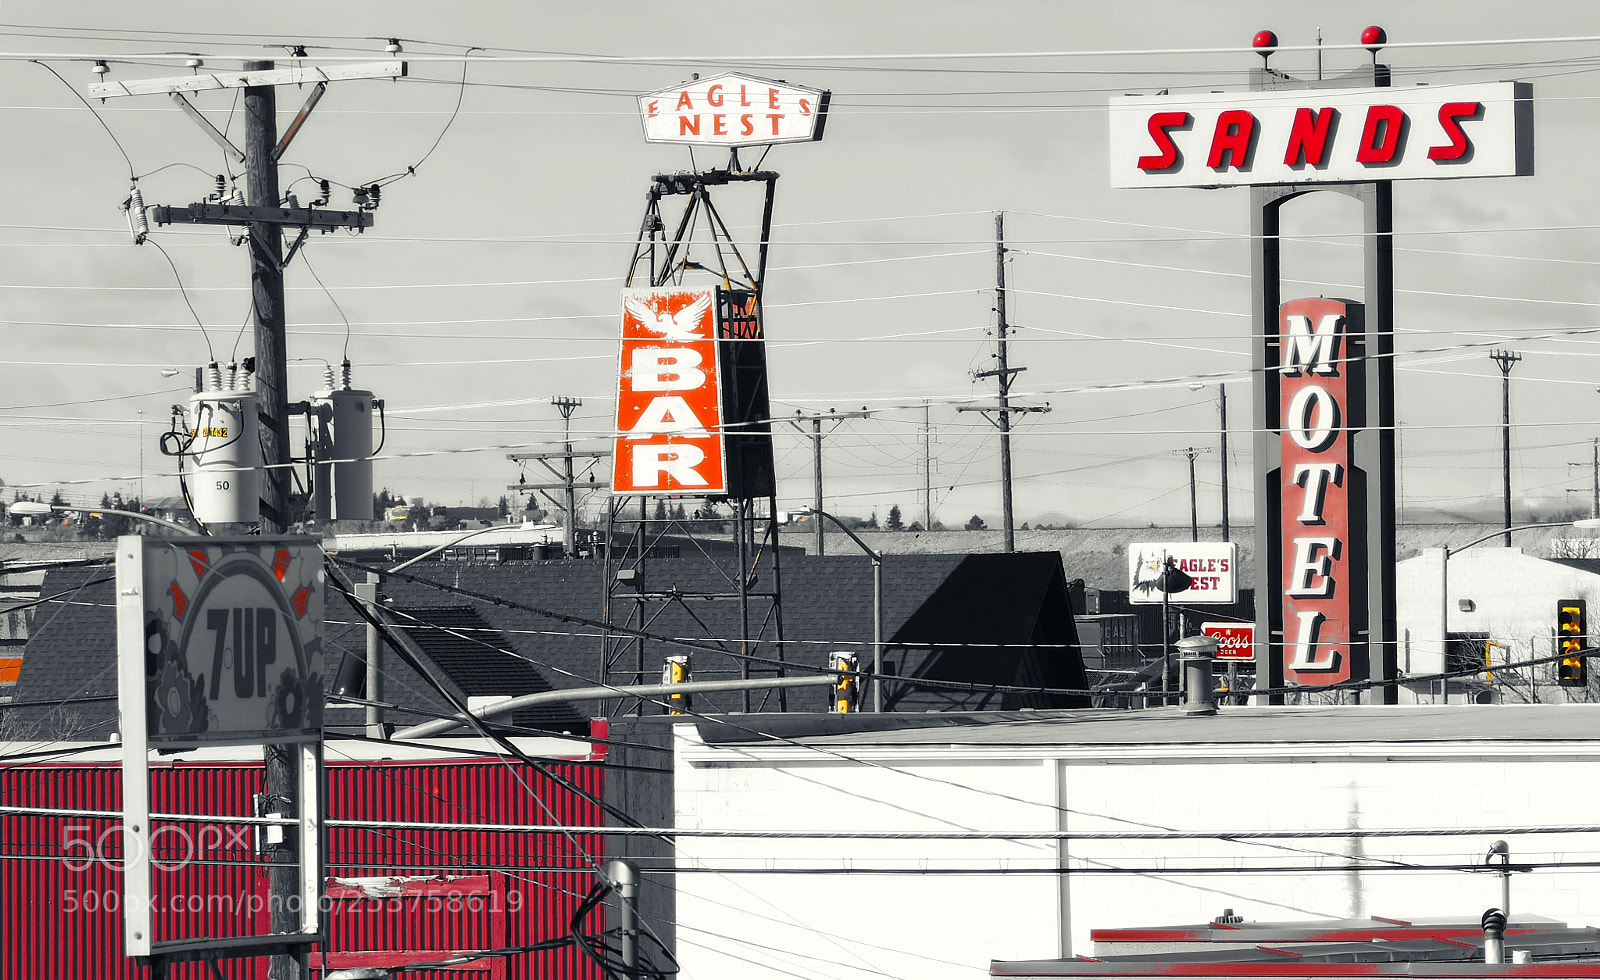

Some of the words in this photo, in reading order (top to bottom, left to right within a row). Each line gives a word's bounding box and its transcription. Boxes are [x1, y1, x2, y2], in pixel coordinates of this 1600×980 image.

[648, 84, 811, 119] EAGLES
[679, 113, 785, 136] NEST
[1137, 102, 1481, 171] SANDS
[627, 346, 711, 489] BAR
[216, 481, 230, 491] 50
[1280, 314, 1345, 673] MOTEL
[1190, 577, 1220, 590] EST
[207, 607, 276, 700] 7UP
